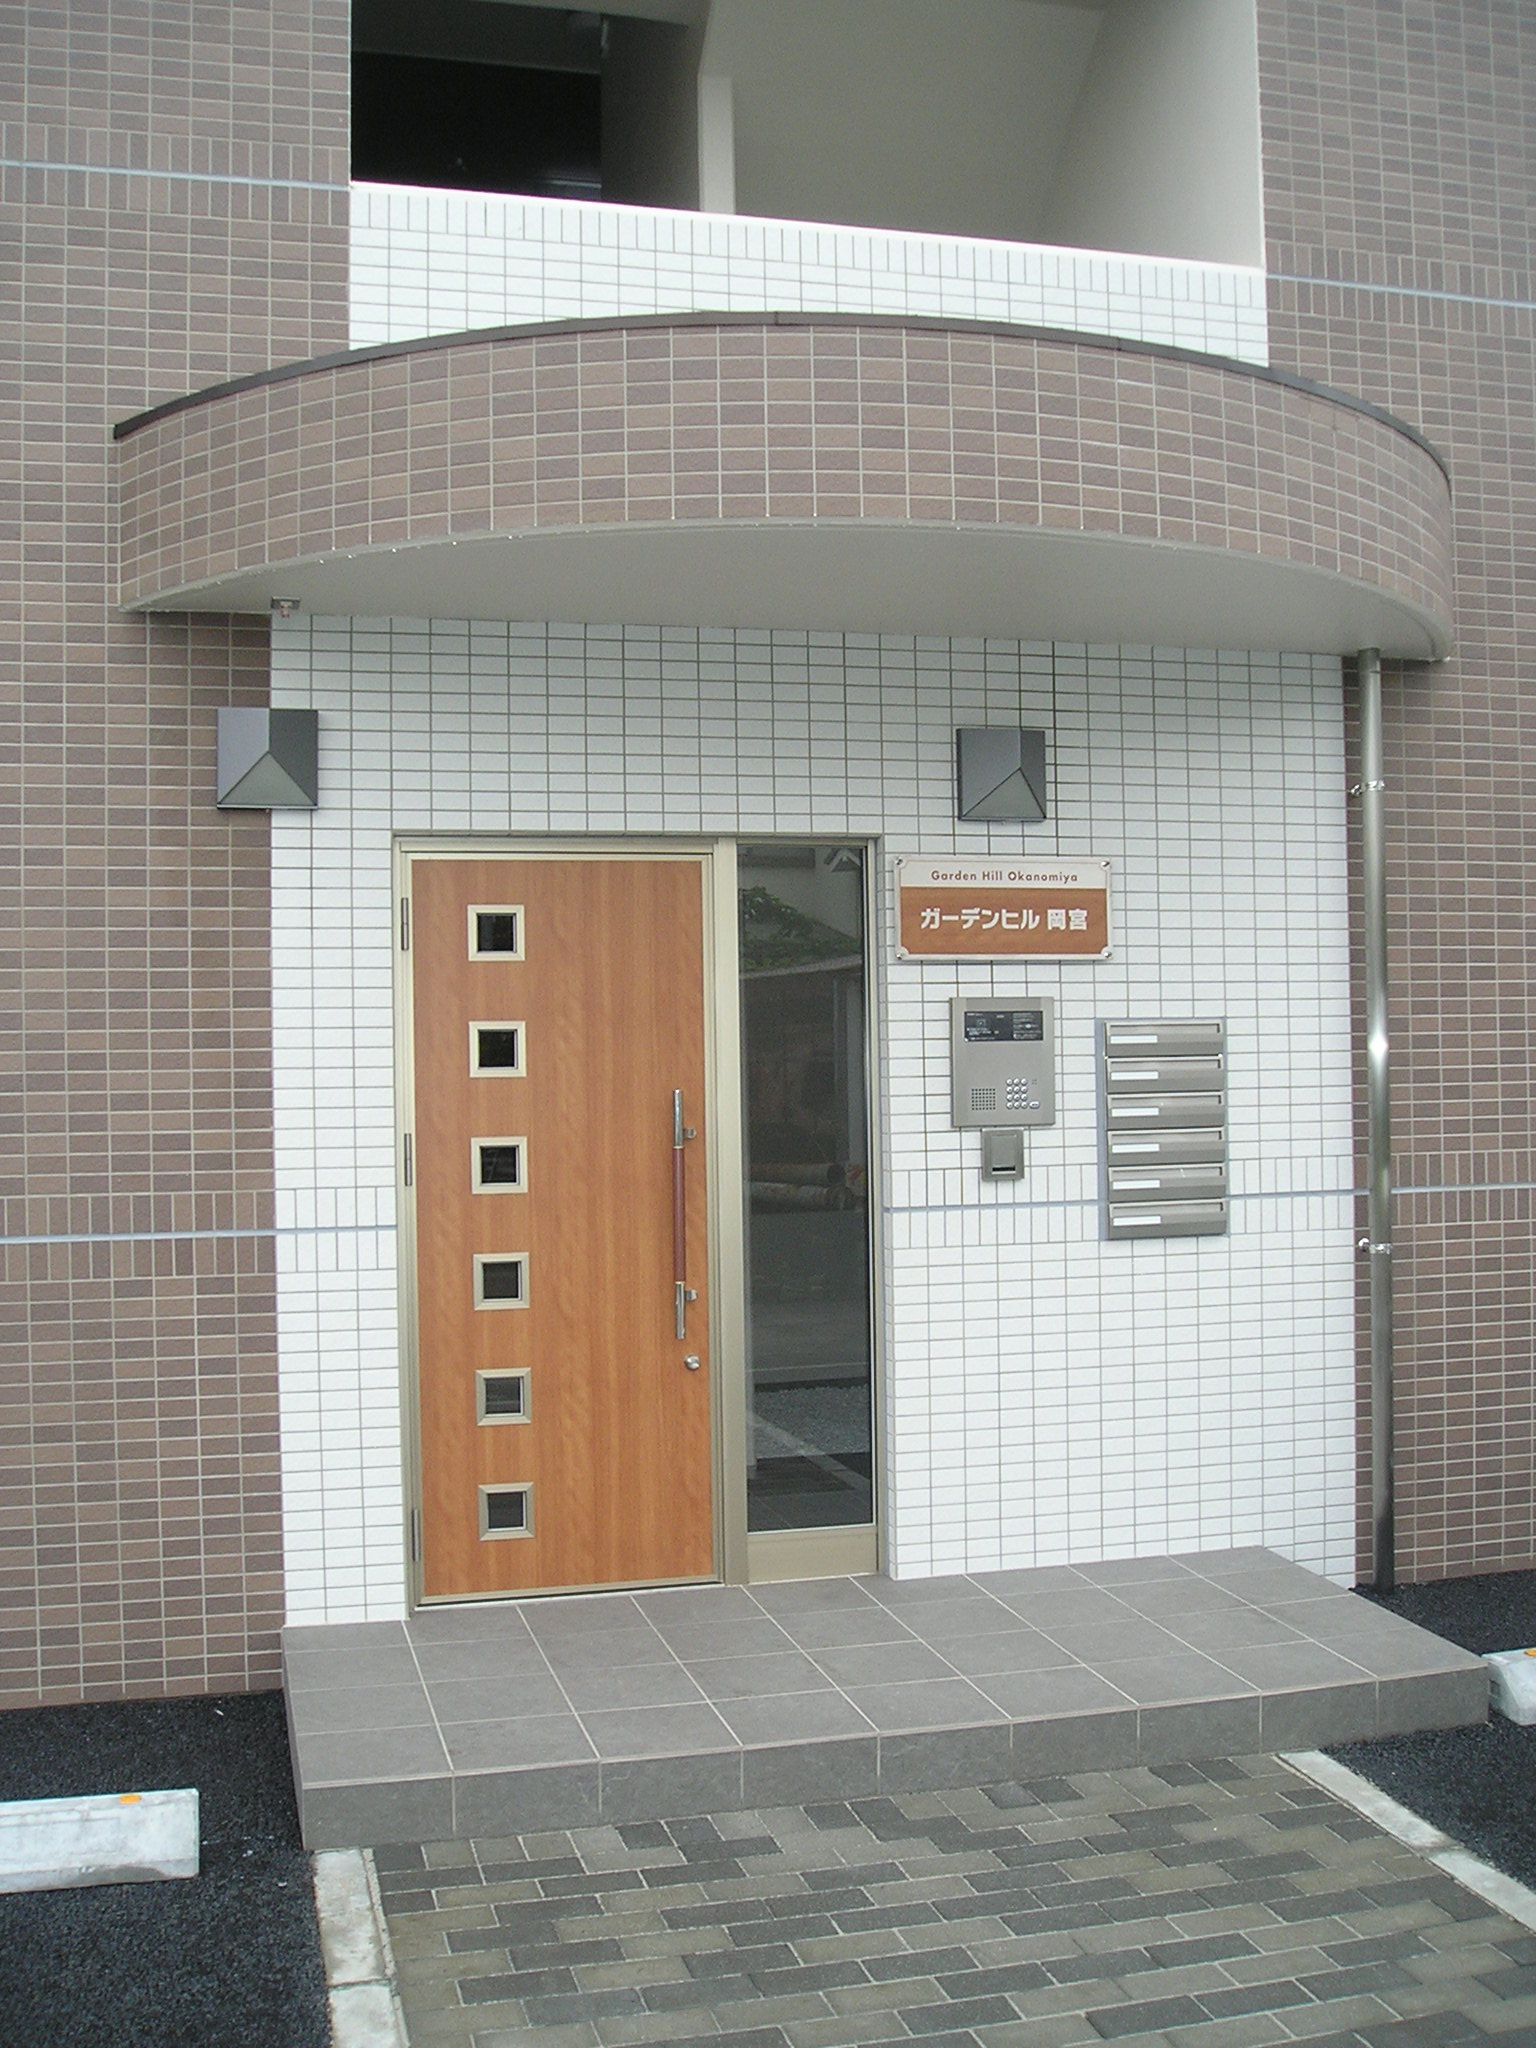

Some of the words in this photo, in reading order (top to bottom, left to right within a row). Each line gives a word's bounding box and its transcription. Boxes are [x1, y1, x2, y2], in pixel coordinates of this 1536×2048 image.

[931, 870, 977, 881] Garden
[982, 870, 1003, 881] Hill
[1008, 871, 1078, 884] Okanomiya
[920, 907, 1040, 930] ガーデンヒル
[1047, 908, 1088, 931] 岡宮
